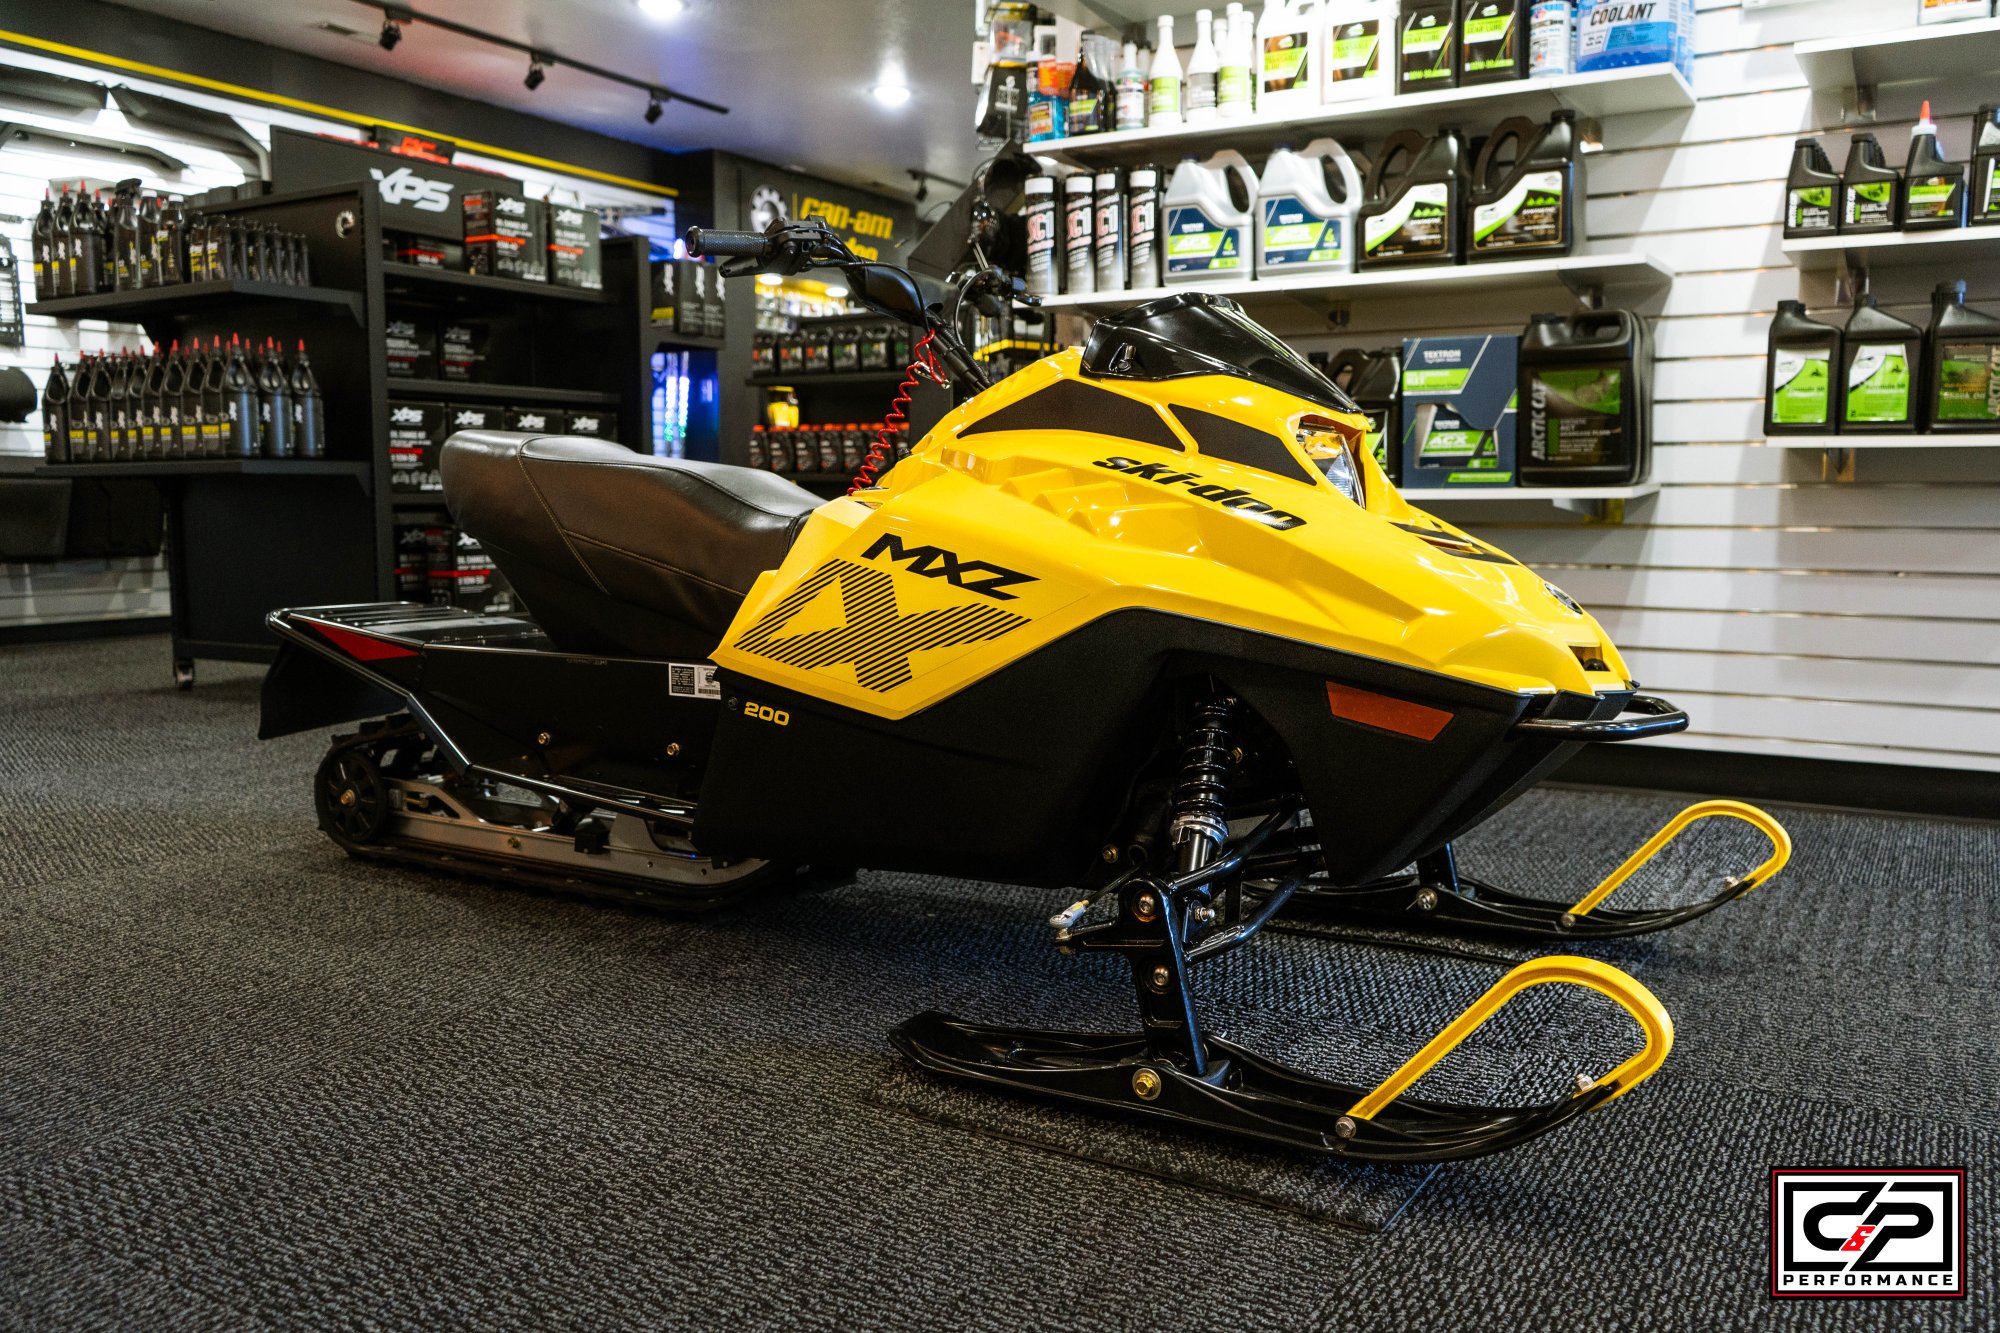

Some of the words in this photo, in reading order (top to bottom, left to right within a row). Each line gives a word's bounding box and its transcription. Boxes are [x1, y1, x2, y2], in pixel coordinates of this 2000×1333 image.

[1590, 2, 1657, 26] COOLANT
[369, 167, 455, 213] XPS
[800, 196, 894, 240] can-am
[1423, 349, 1461, 358] TEXTRON
[1531, 379, 1548, 409] CAT
[390, 406, 424, 423] XPS
[454, 410, 486, 425] XPS
[517, 413, 546, 429] XPS
[571, 416, 600, 431] XPS
[1530, 410, 1546, 460] ARCTIC
[1092, 456, 1307, 531] ski-doo
[860, 532, 1042, 601] MXZ
[744, 701, 790, 726] 200
